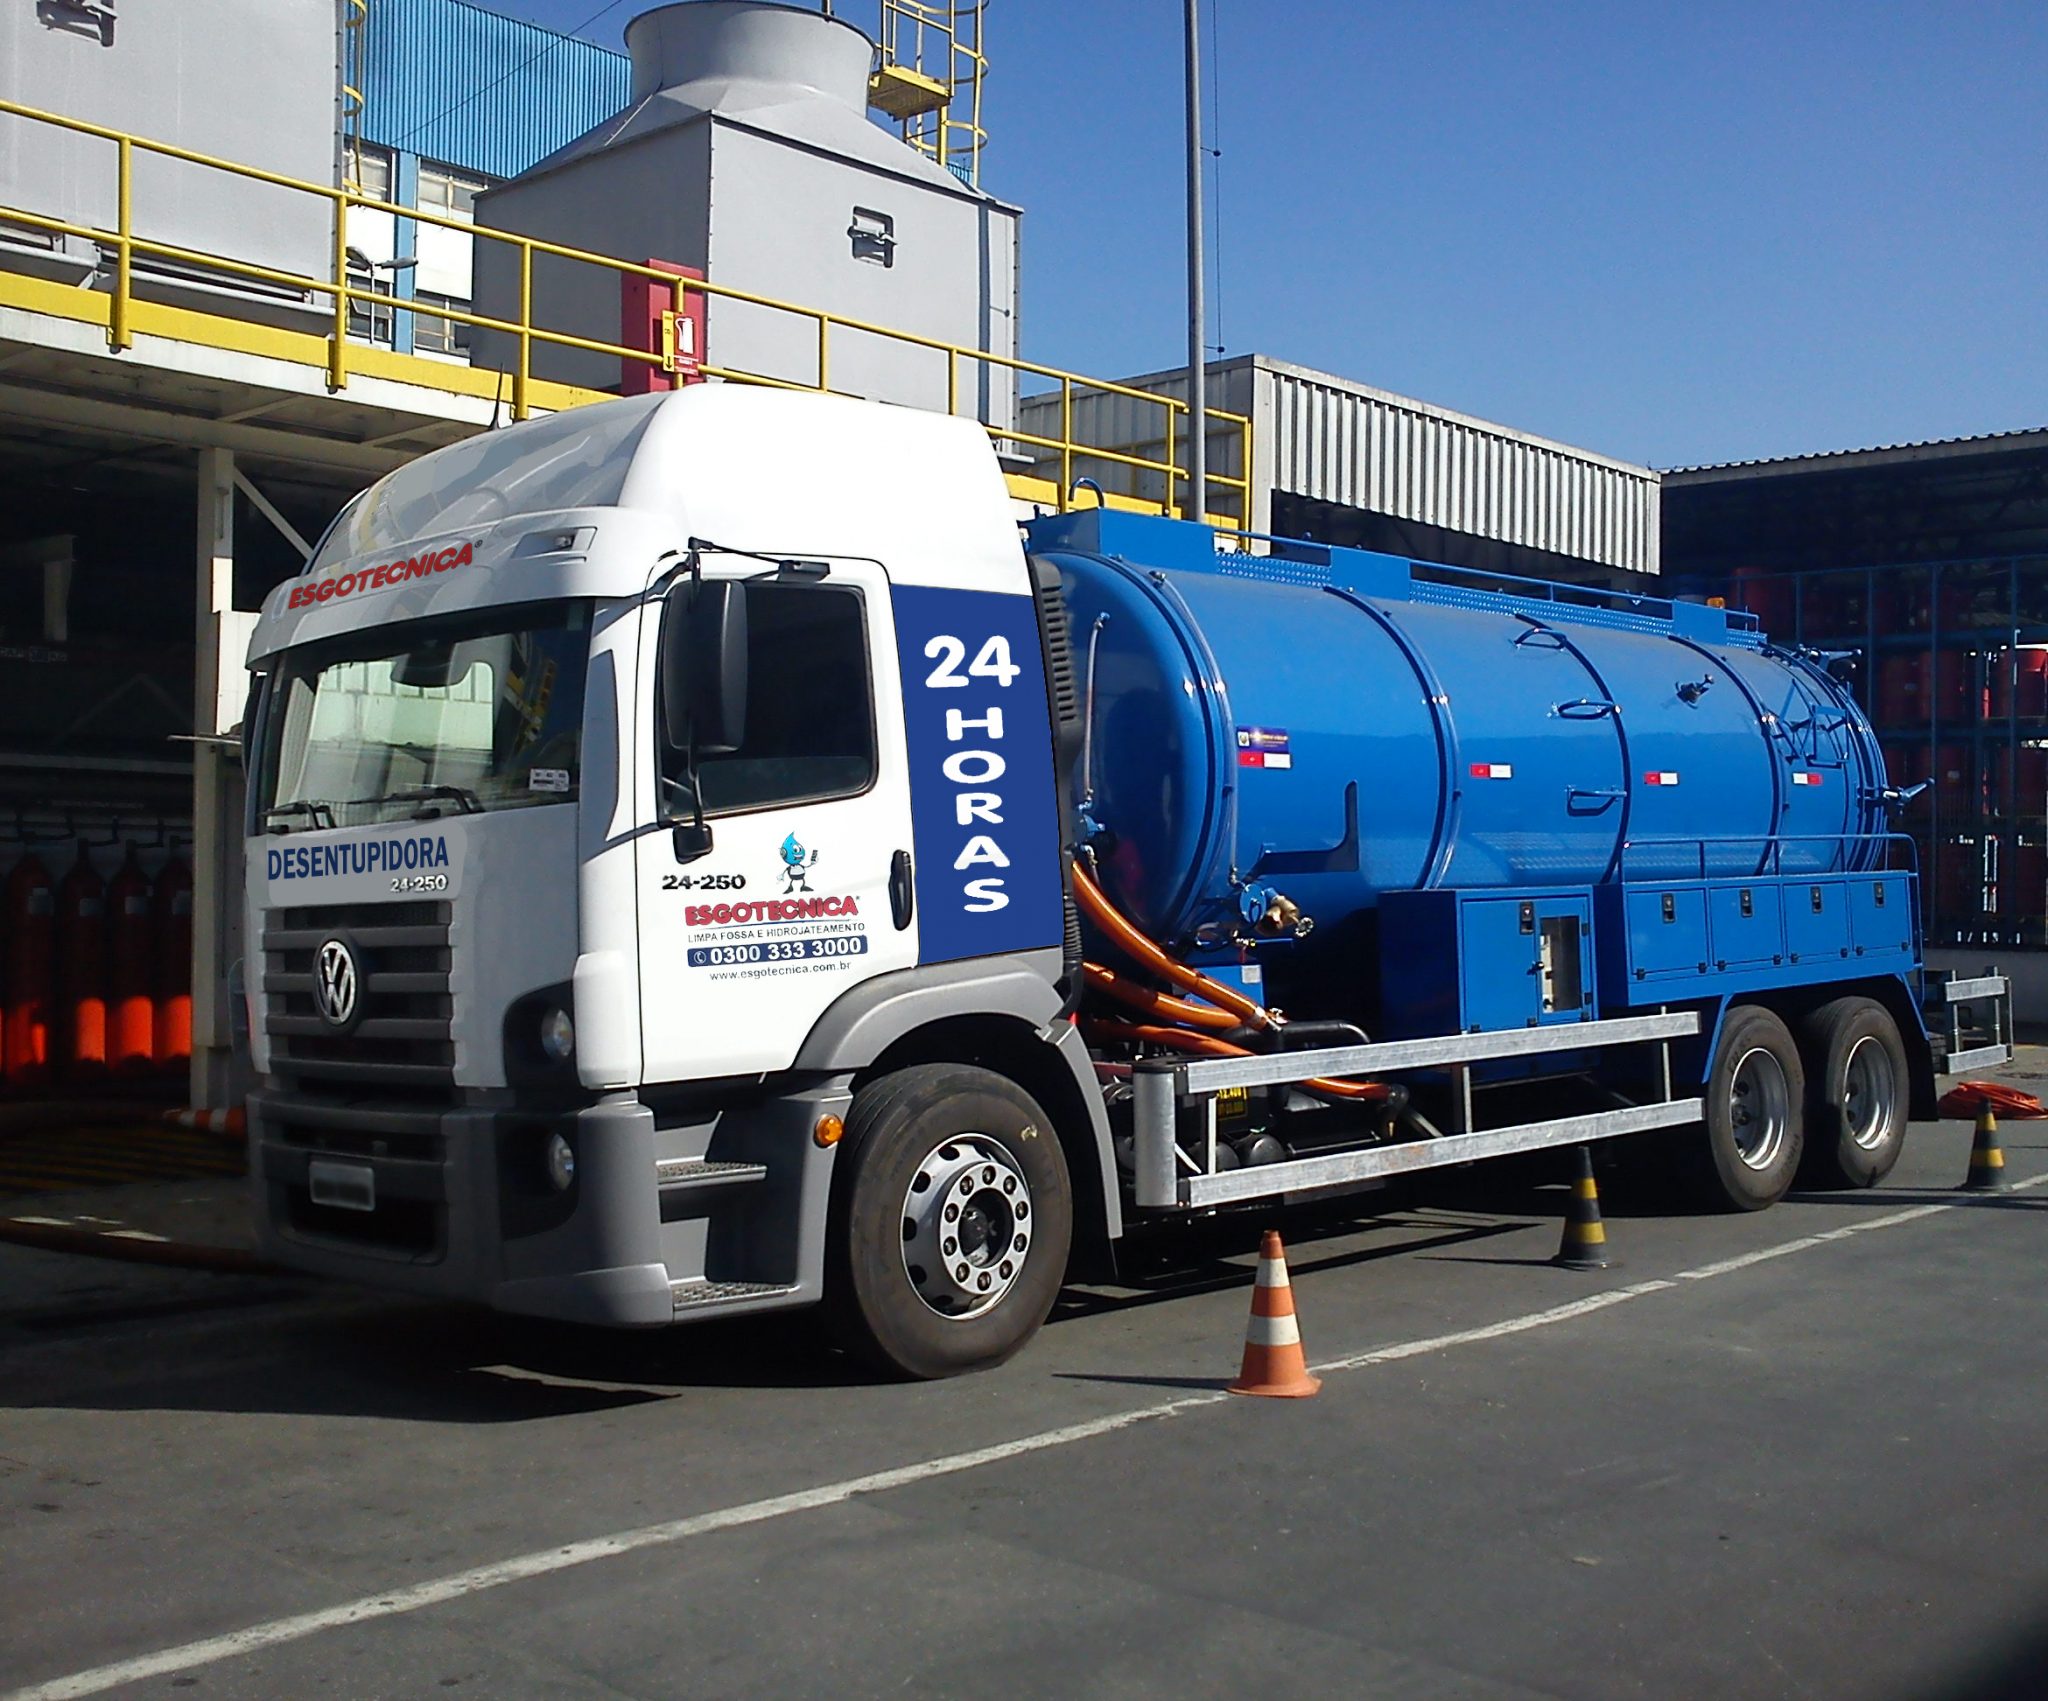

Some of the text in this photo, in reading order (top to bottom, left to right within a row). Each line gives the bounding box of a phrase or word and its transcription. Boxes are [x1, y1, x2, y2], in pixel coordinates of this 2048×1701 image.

[288, 543, 473, 609] ESGOTECNICA
[924, 635, 1021, 688] 24
[942, 707, 1010, 912] HORAS
[268, 836, 449, 880] DESENTUPIDORA
[390, 874, 448, 893] 24-250
[661, 874, 746, 890] 24-250
[684, 896, 859, 926] ESGOTECNICA
[688, 922, 865, 943] LIMPA FOSSA E HIDROJATEAMENTO
[710, 937, 862, 965] 0300 333 3000
[709, 961, 851, 981] www.esgotecnica.com.br
